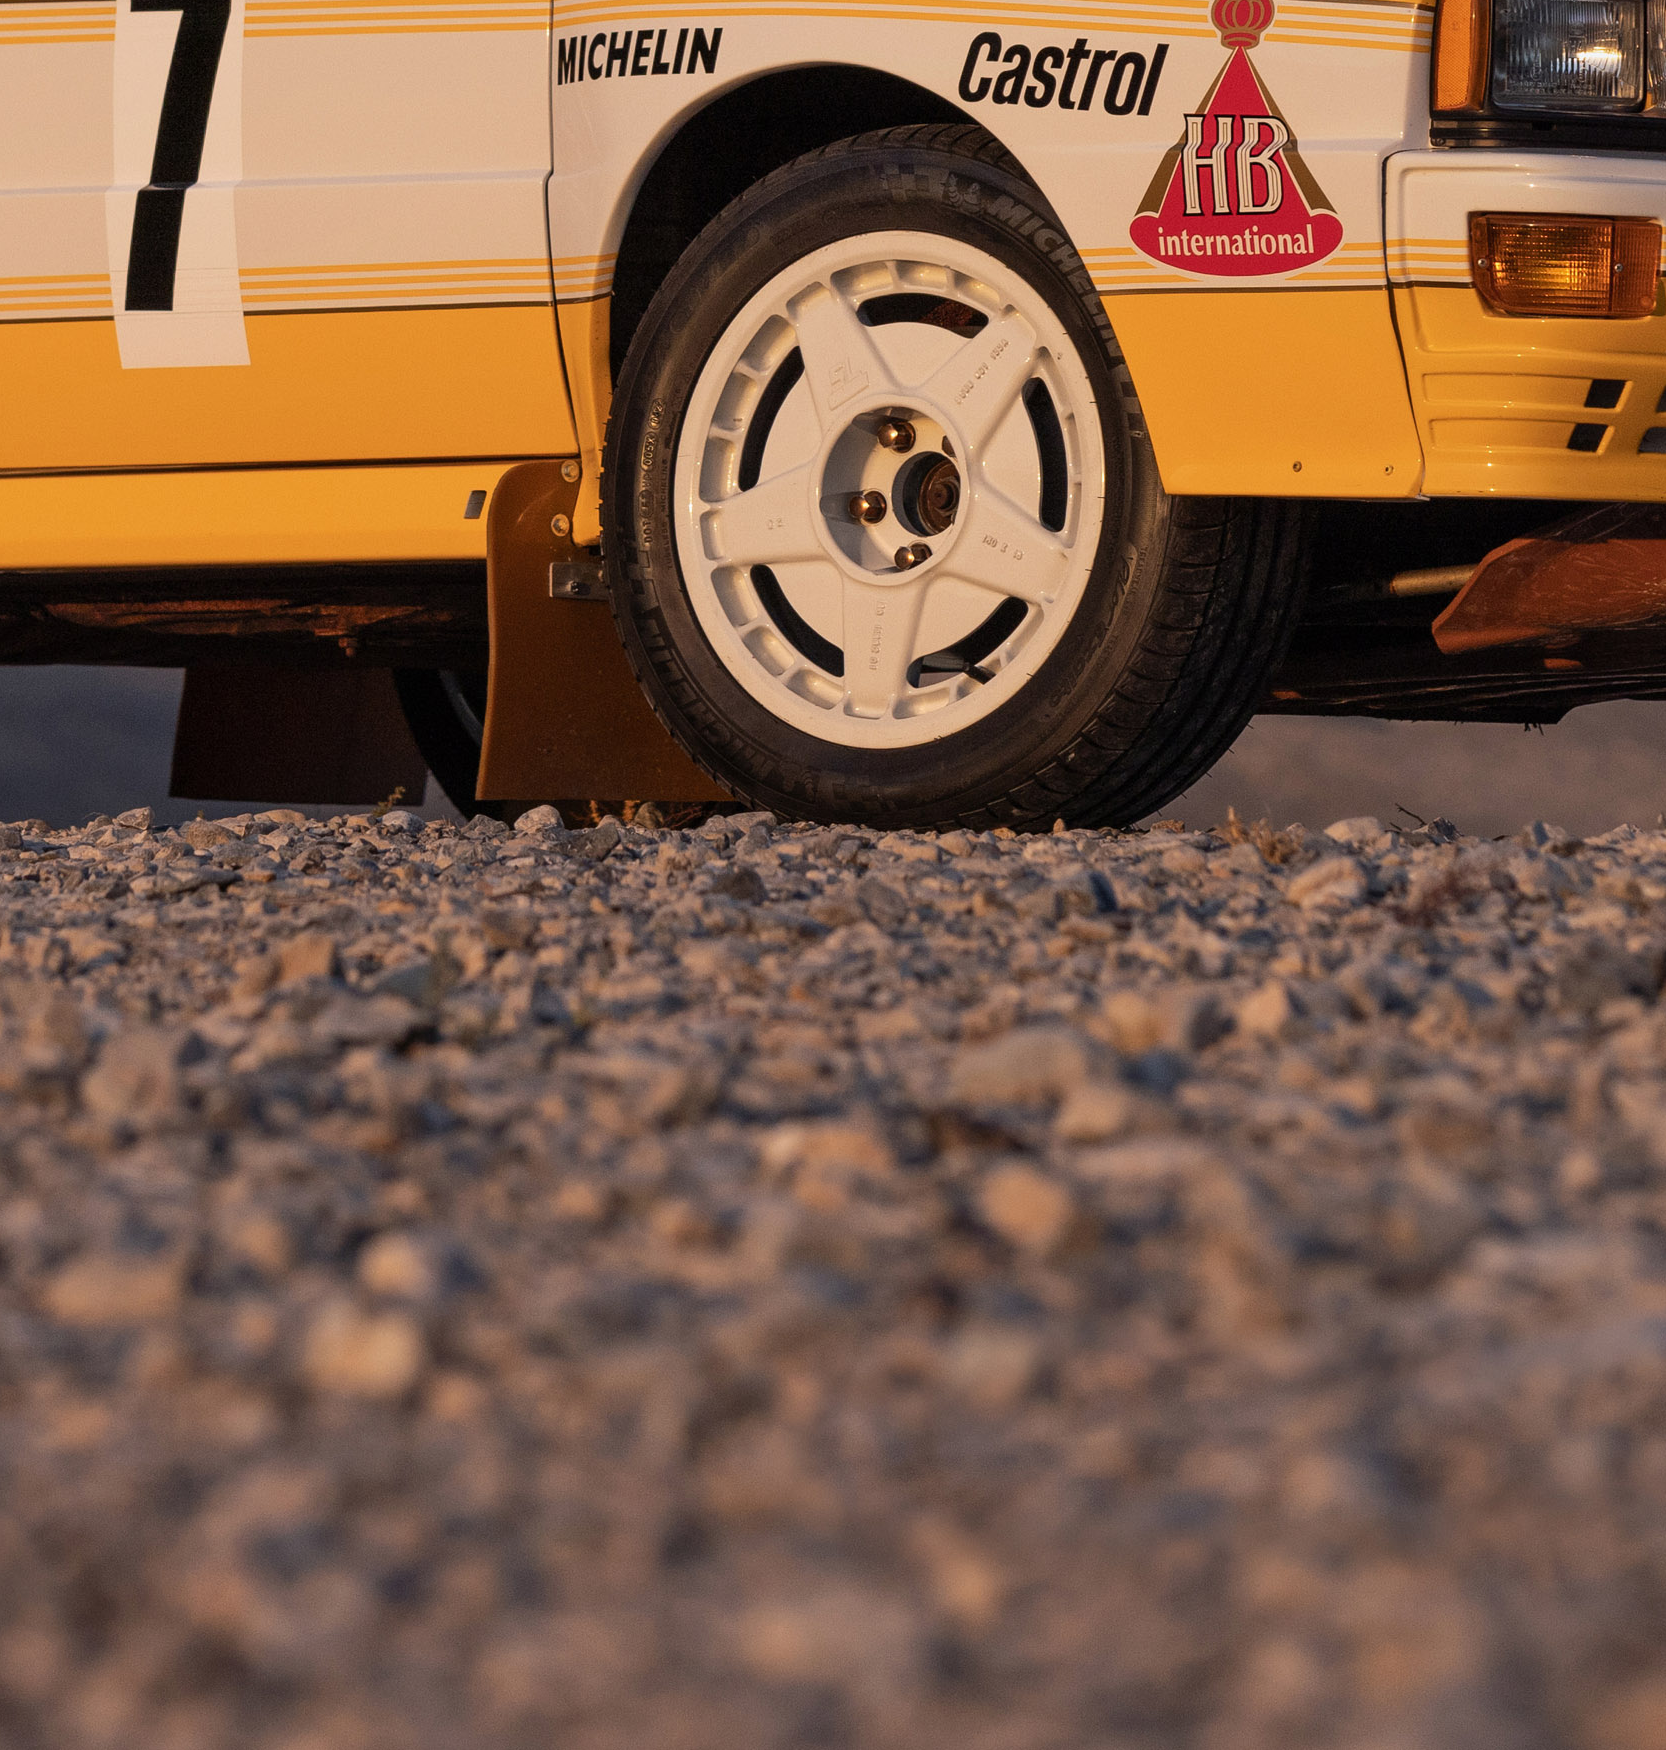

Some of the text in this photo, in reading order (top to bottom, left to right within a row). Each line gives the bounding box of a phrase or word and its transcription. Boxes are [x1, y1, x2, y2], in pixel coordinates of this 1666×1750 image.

[556, 27, 724, 86] MICHELIN
[958, 31, 1169, 116] Castrol
[1180, 112, 1292, 218] HB
[1158, 223, 1315, 257] international
